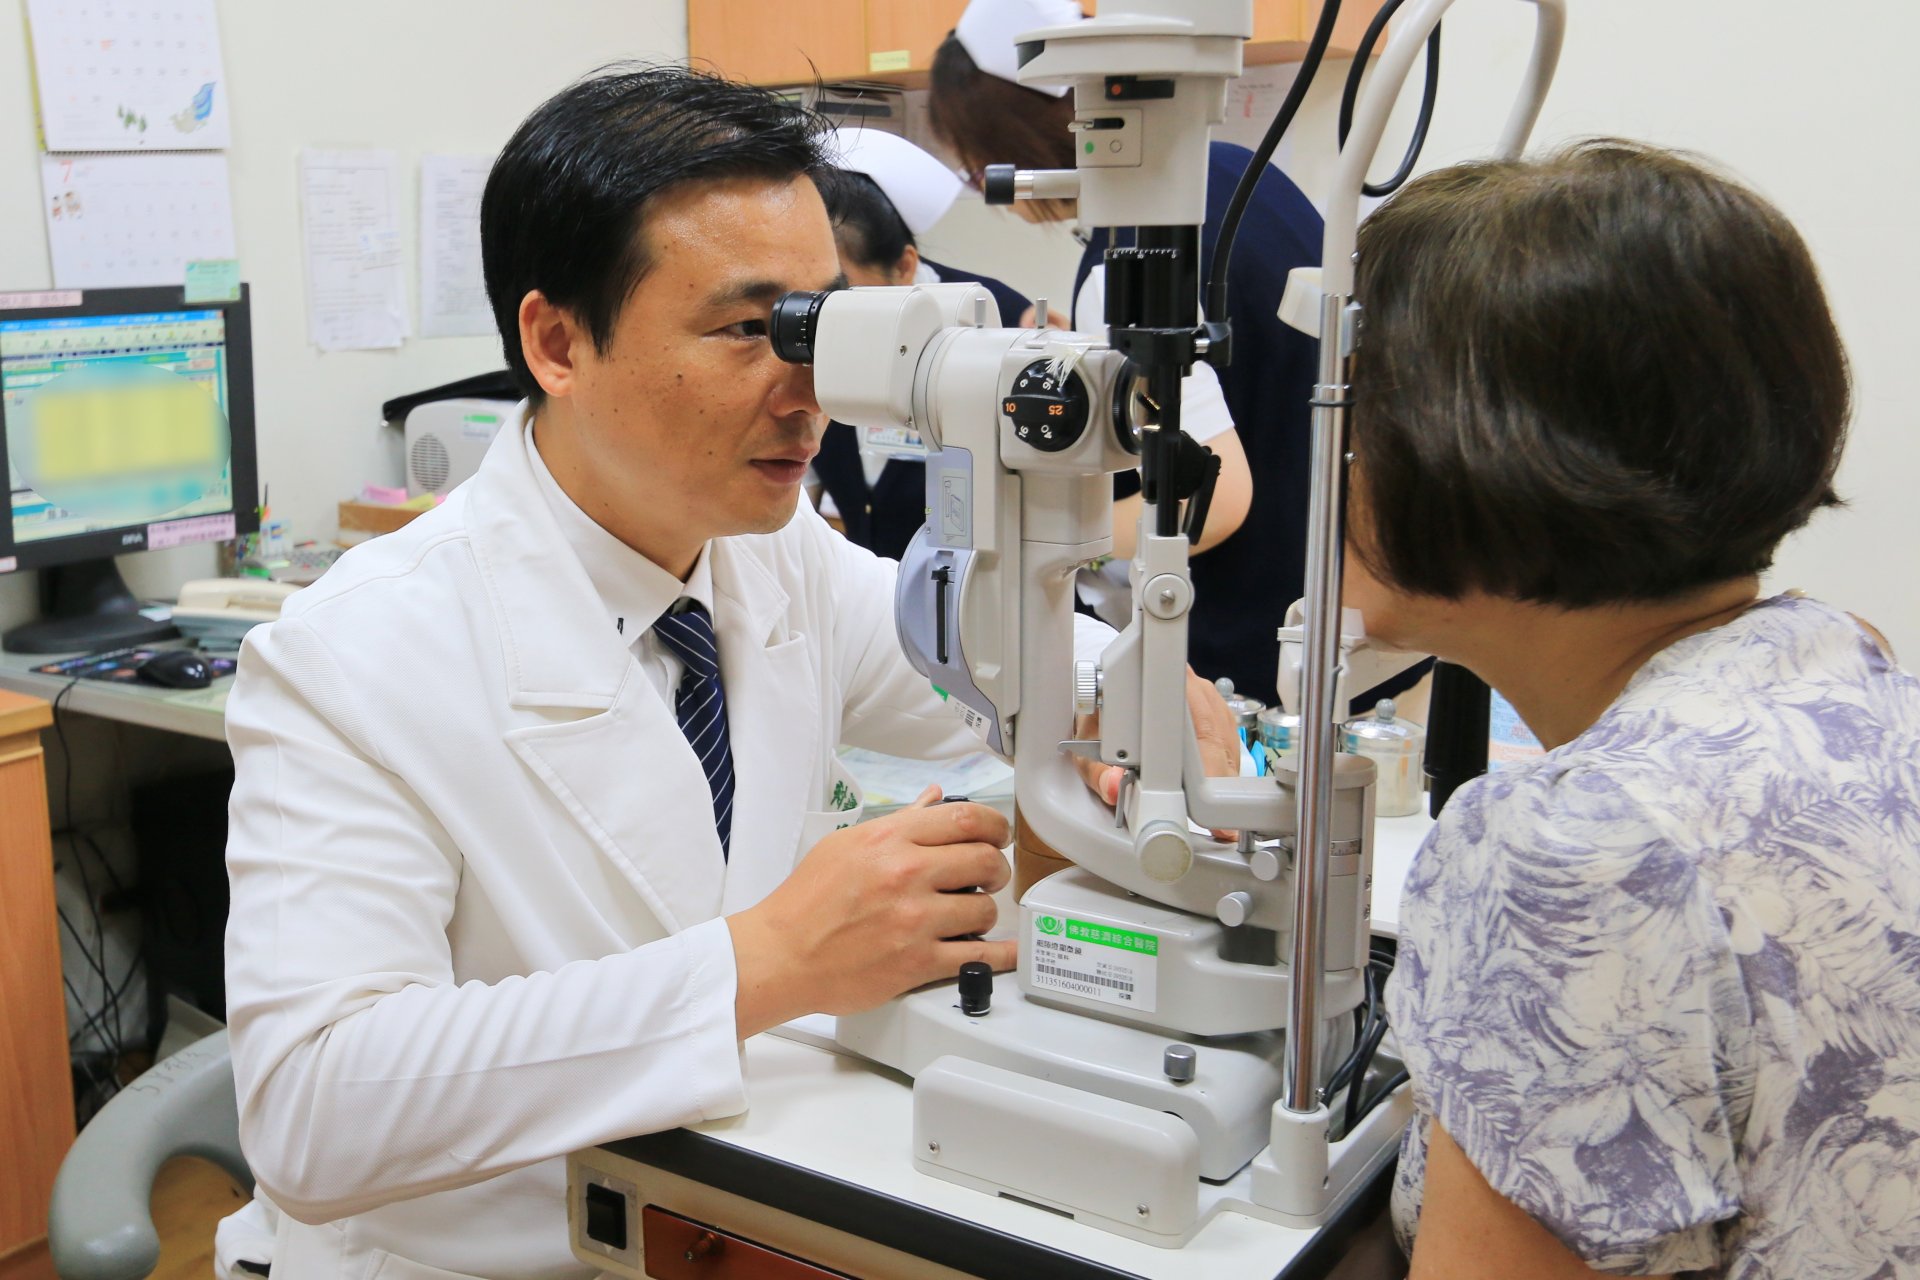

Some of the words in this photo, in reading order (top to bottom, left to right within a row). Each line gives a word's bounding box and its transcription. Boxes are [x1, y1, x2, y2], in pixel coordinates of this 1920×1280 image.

[1042, 377, 1055, 391] 16
[1005, 402, 1016, 413] 10
[1048, 404, 1064, 415] 25
[1018, 425, 1029, 438] 16
[1040, 424, 1053, 439] 40
[1036, 975, 1102, 997] 311351604000011
